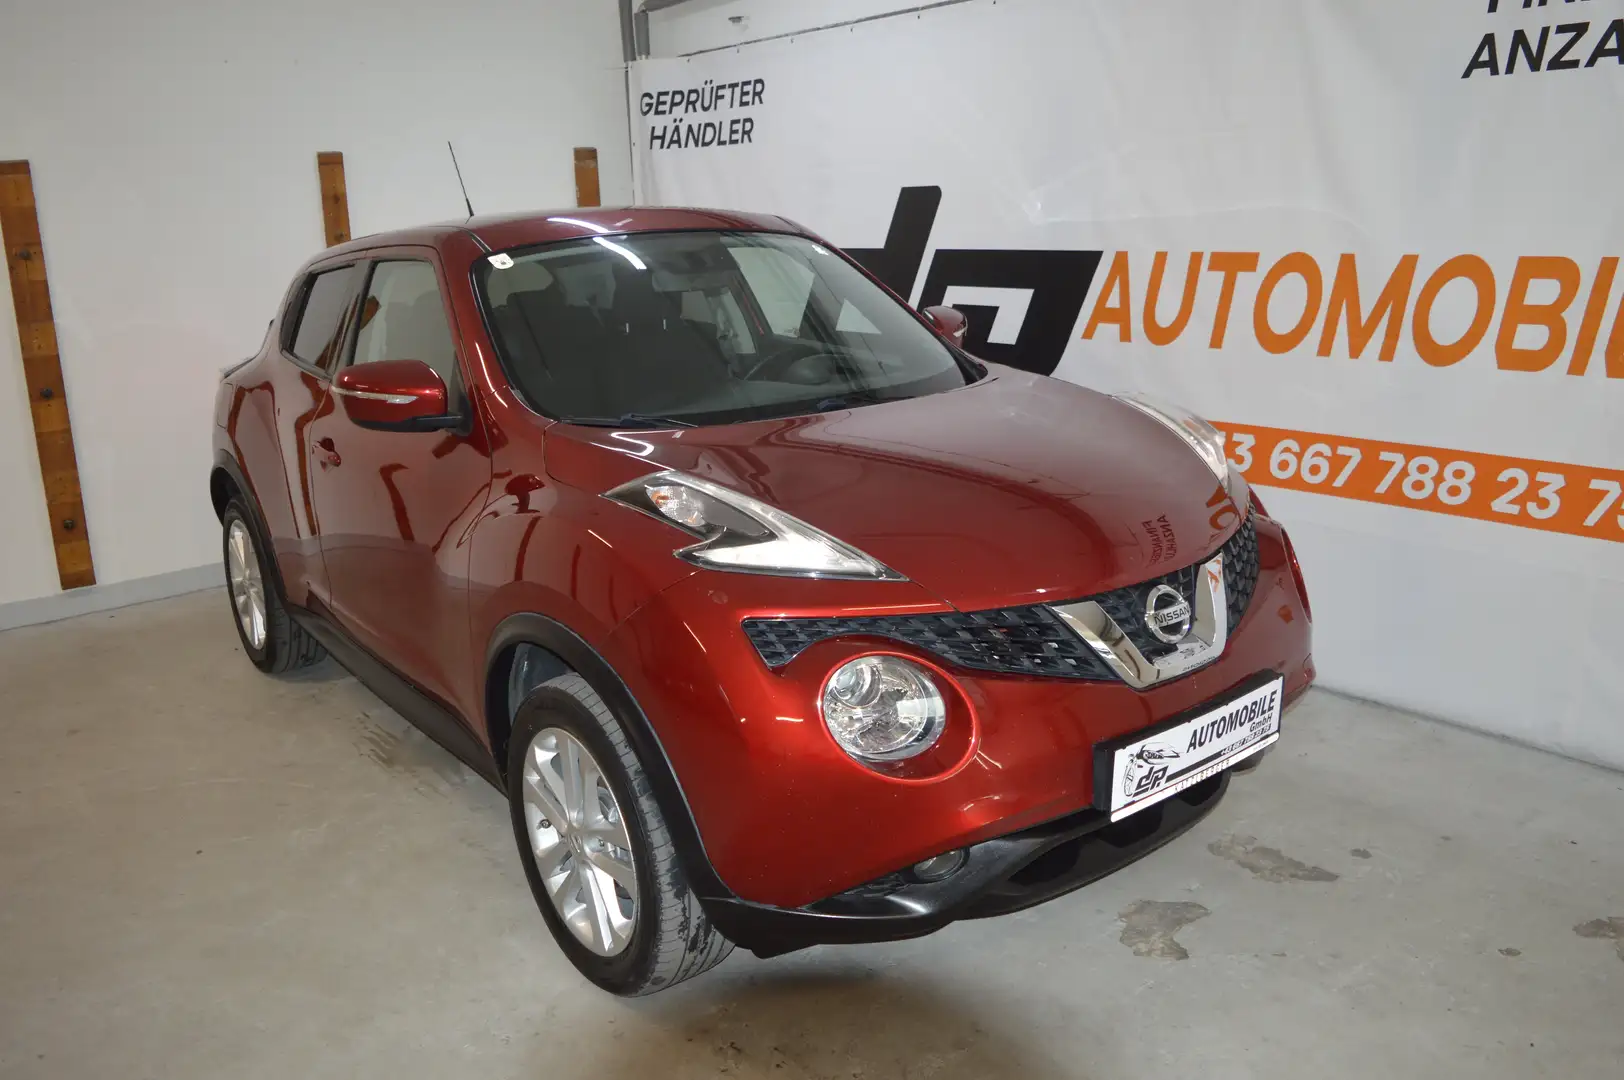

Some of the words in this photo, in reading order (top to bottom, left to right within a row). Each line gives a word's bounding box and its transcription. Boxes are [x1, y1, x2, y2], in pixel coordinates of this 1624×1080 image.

[640, 78, 765, 117] GEPRÜFTER
[649, 117, 754, 150] HÄNDLER
[1269, 438, 1362, 487] 667
[1374, 451, 1476, 506] 788
[1490, 467, 1566, 520] 23
[1583, 478, 1624, 531] 7
[1154, 605, 1190, 625] NISSAN
[1186, 689, 1278, 754] AUTOMOBILE
[1250, 712, 1273, 732] GmbH
